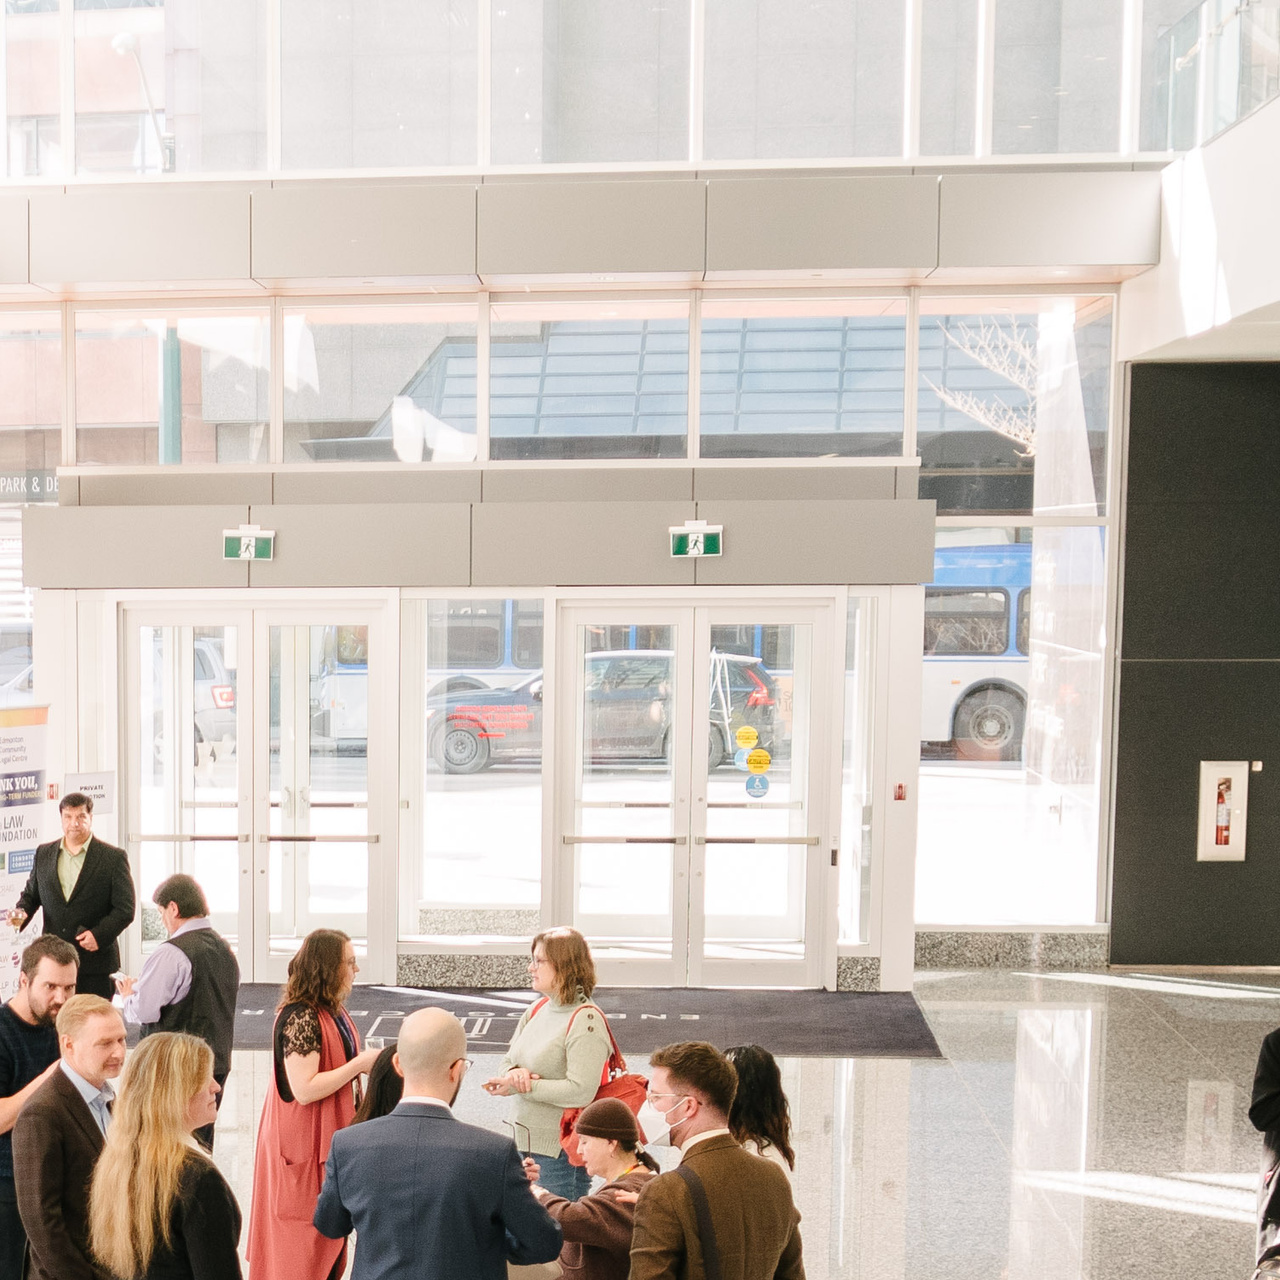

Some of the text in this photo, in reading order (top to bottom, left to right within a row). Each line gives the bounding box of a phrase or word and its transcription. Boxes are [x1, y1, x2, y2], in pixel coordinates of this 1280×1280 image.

[0, 476, 27, 492] PARK
[31, 476, 40, 492] &
[14, 775, 38, 790] YOU,
[3, 815, 24, 829] LAW
